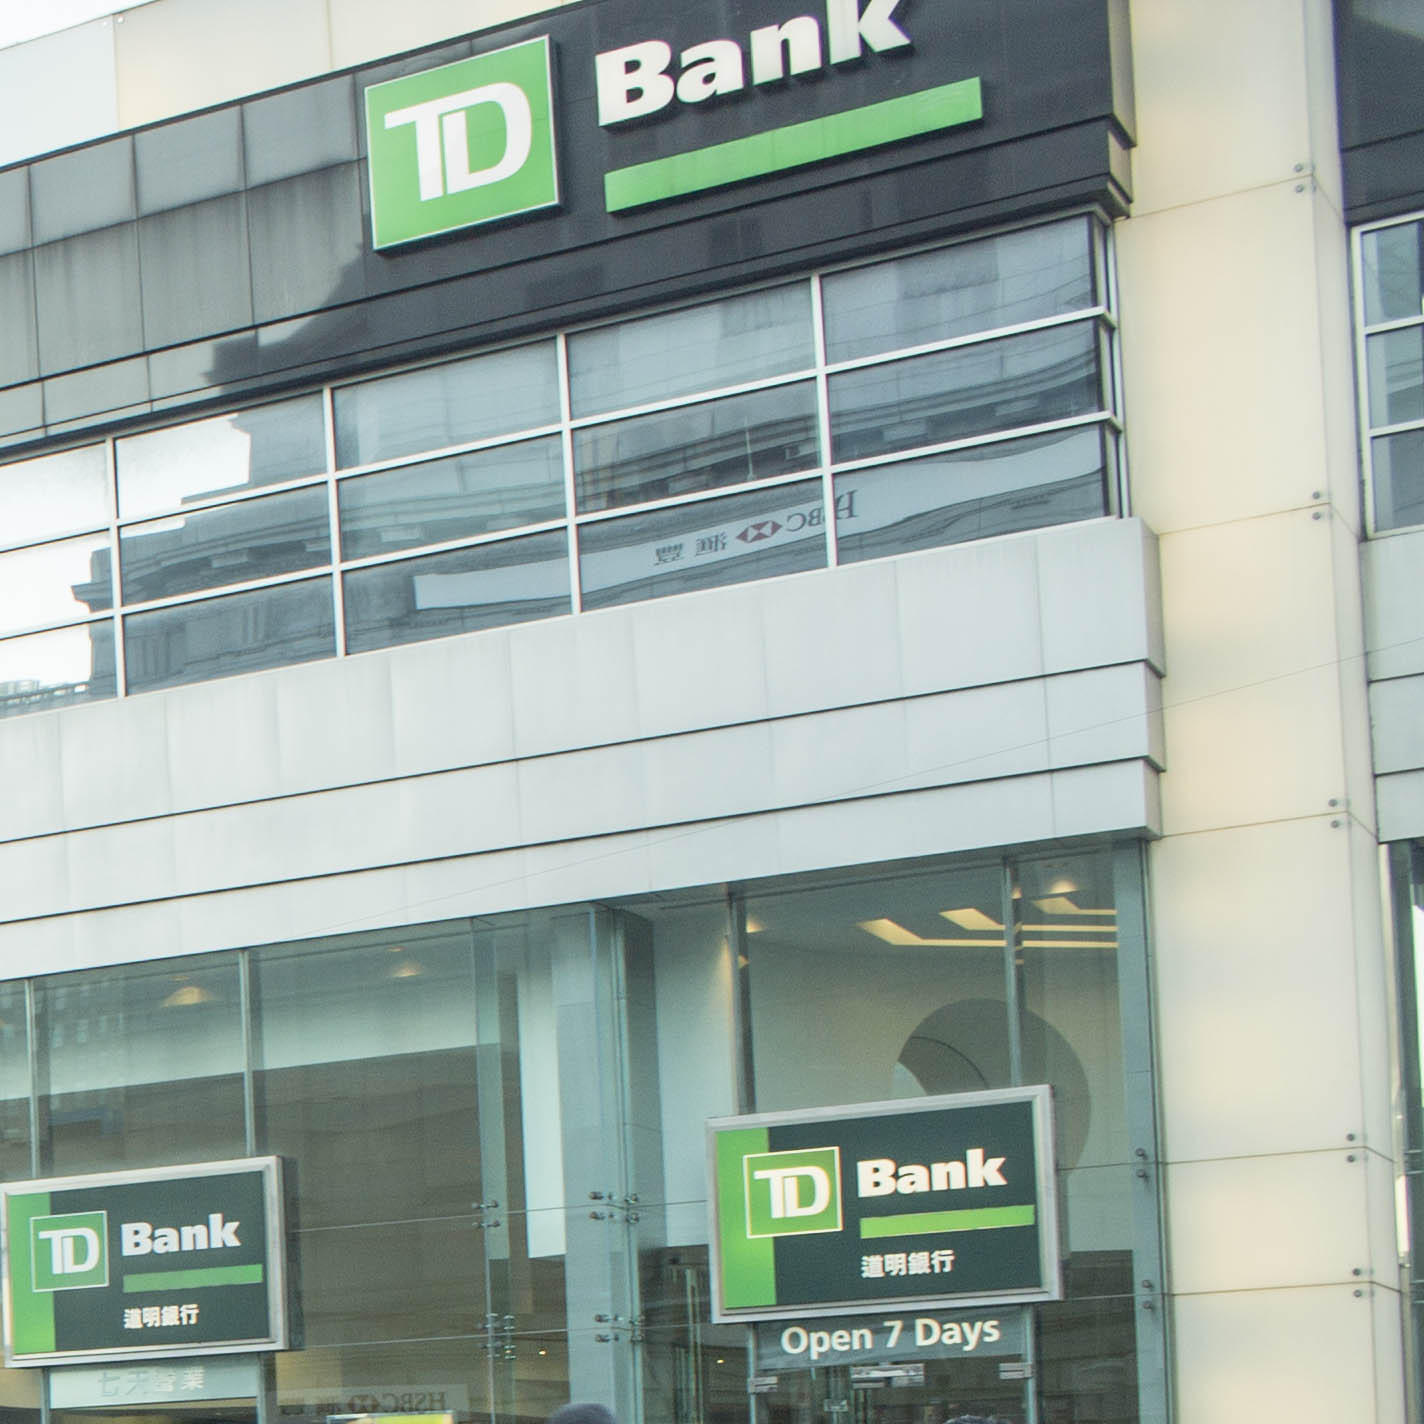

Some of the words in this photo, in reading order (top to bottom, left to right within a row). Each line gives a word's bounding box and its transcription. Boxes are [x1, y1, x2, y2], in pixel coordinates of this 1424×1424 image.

[383, 81, 533, 202] TD
[596, 0, 912, 127] Bank
[753, 1164, 830, 1220] TD
[856, 1148, 1008, 1198] Bank
[38, 1226, 100, 1275] TD
[119, 1212, 242, 1257] Bank
[860, 1249, 955, 1278] 道明銀行
[123, 1303, 200, 1329] 道明銀行
[780, 1326, 874, 1360] Open
[883, 1320, 904, 1349] 7
[914, 1317, 1001, 1352] Days
